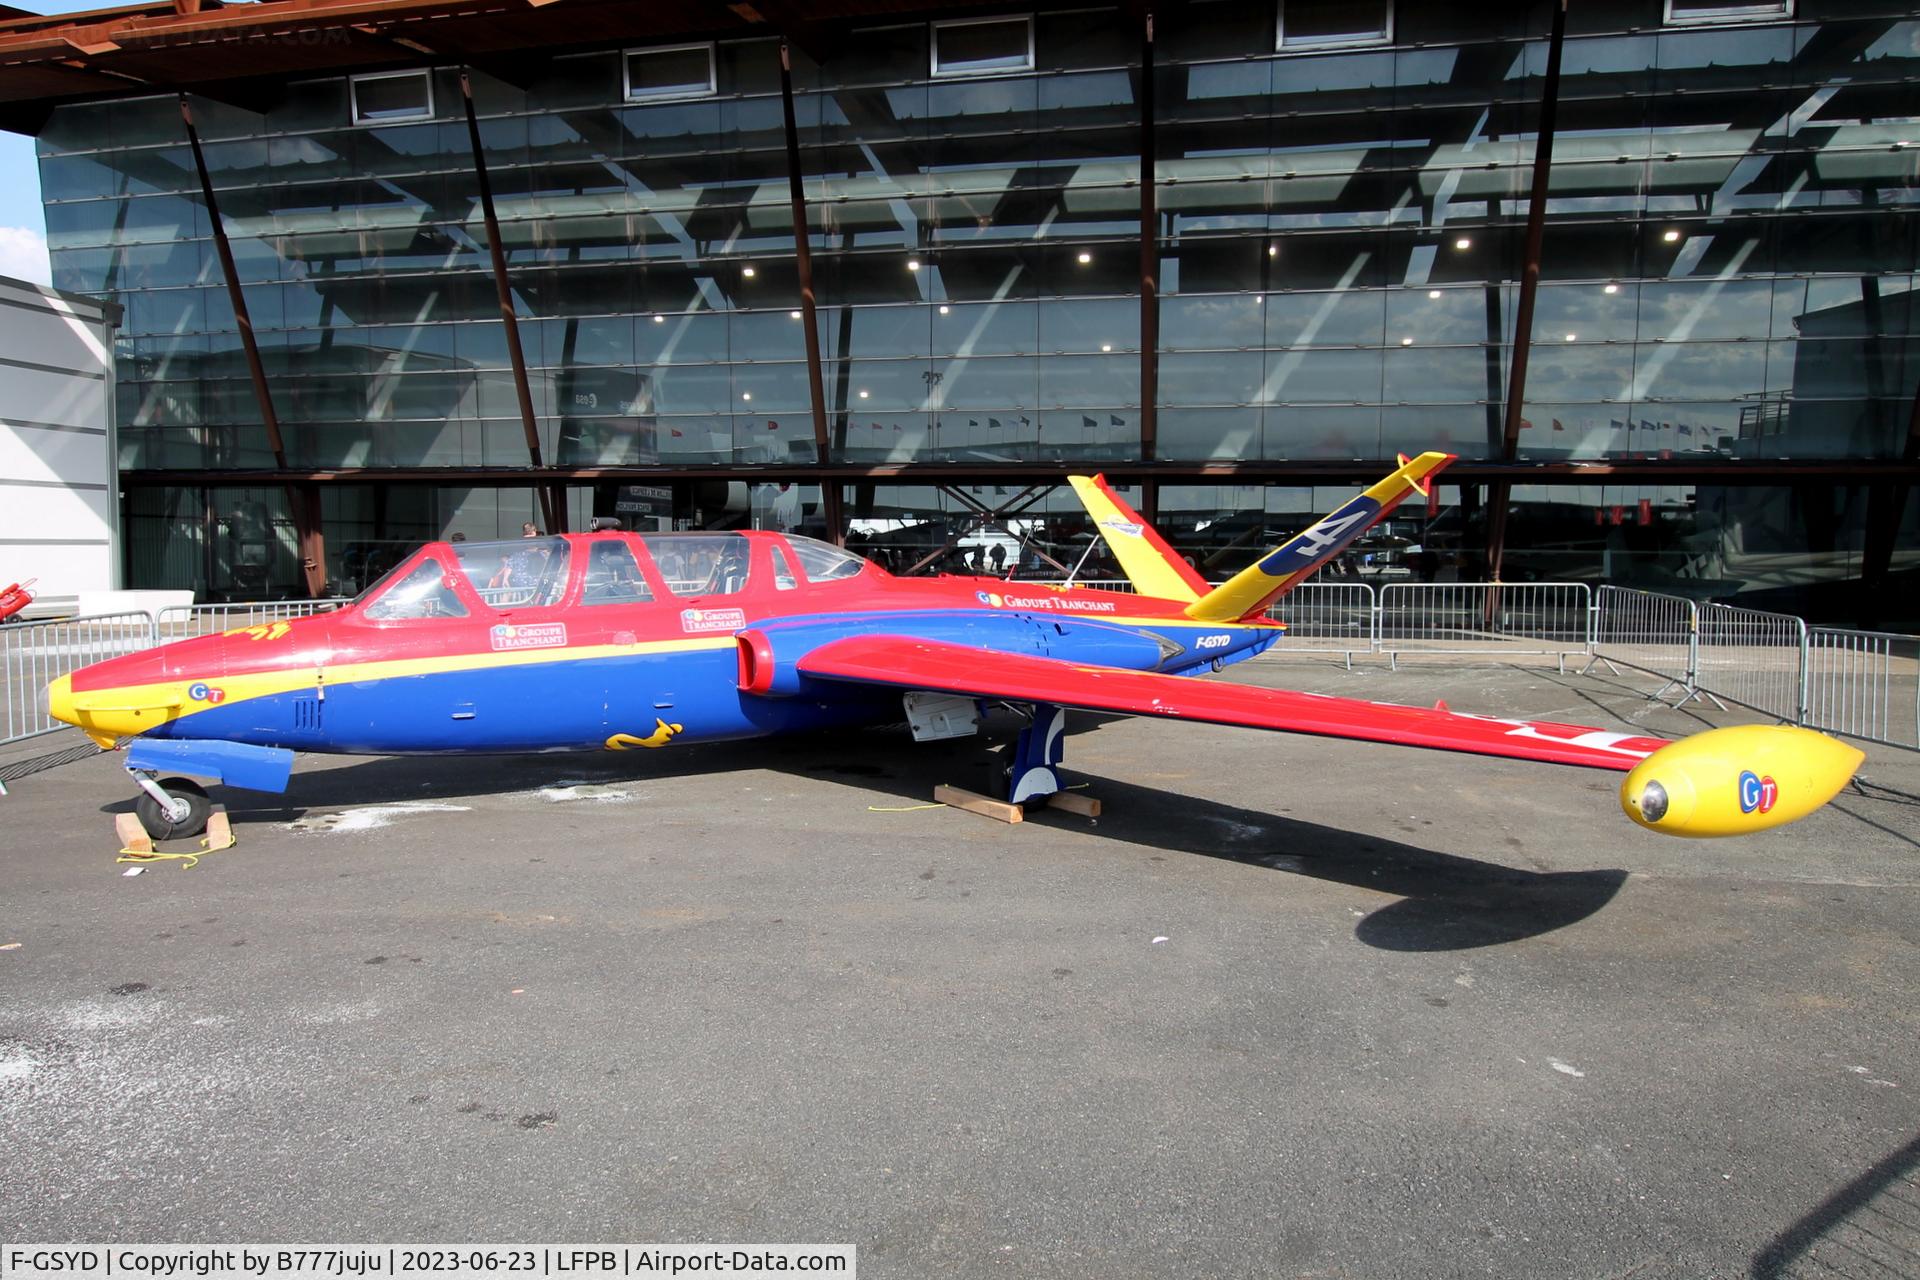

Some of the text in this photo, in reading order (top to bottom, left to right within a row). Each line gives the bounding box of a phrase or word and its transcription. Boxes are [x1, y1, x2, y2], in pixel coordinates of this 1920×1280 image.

[1295, 510, 1368, 557] 4
[1003, 594, 1052, 609] GROUPE
[1053, 597, 1116, 612] TRANCHANT
[703, 611, 741, 621] GROUPE
[686, 619, 742, 630] TRANCHANT
[518, 627, 562, 637] GROUPE
[496, 635, 563, 648] TRANCHANT
[1195, 634, 1231, 649] F-GSYD
